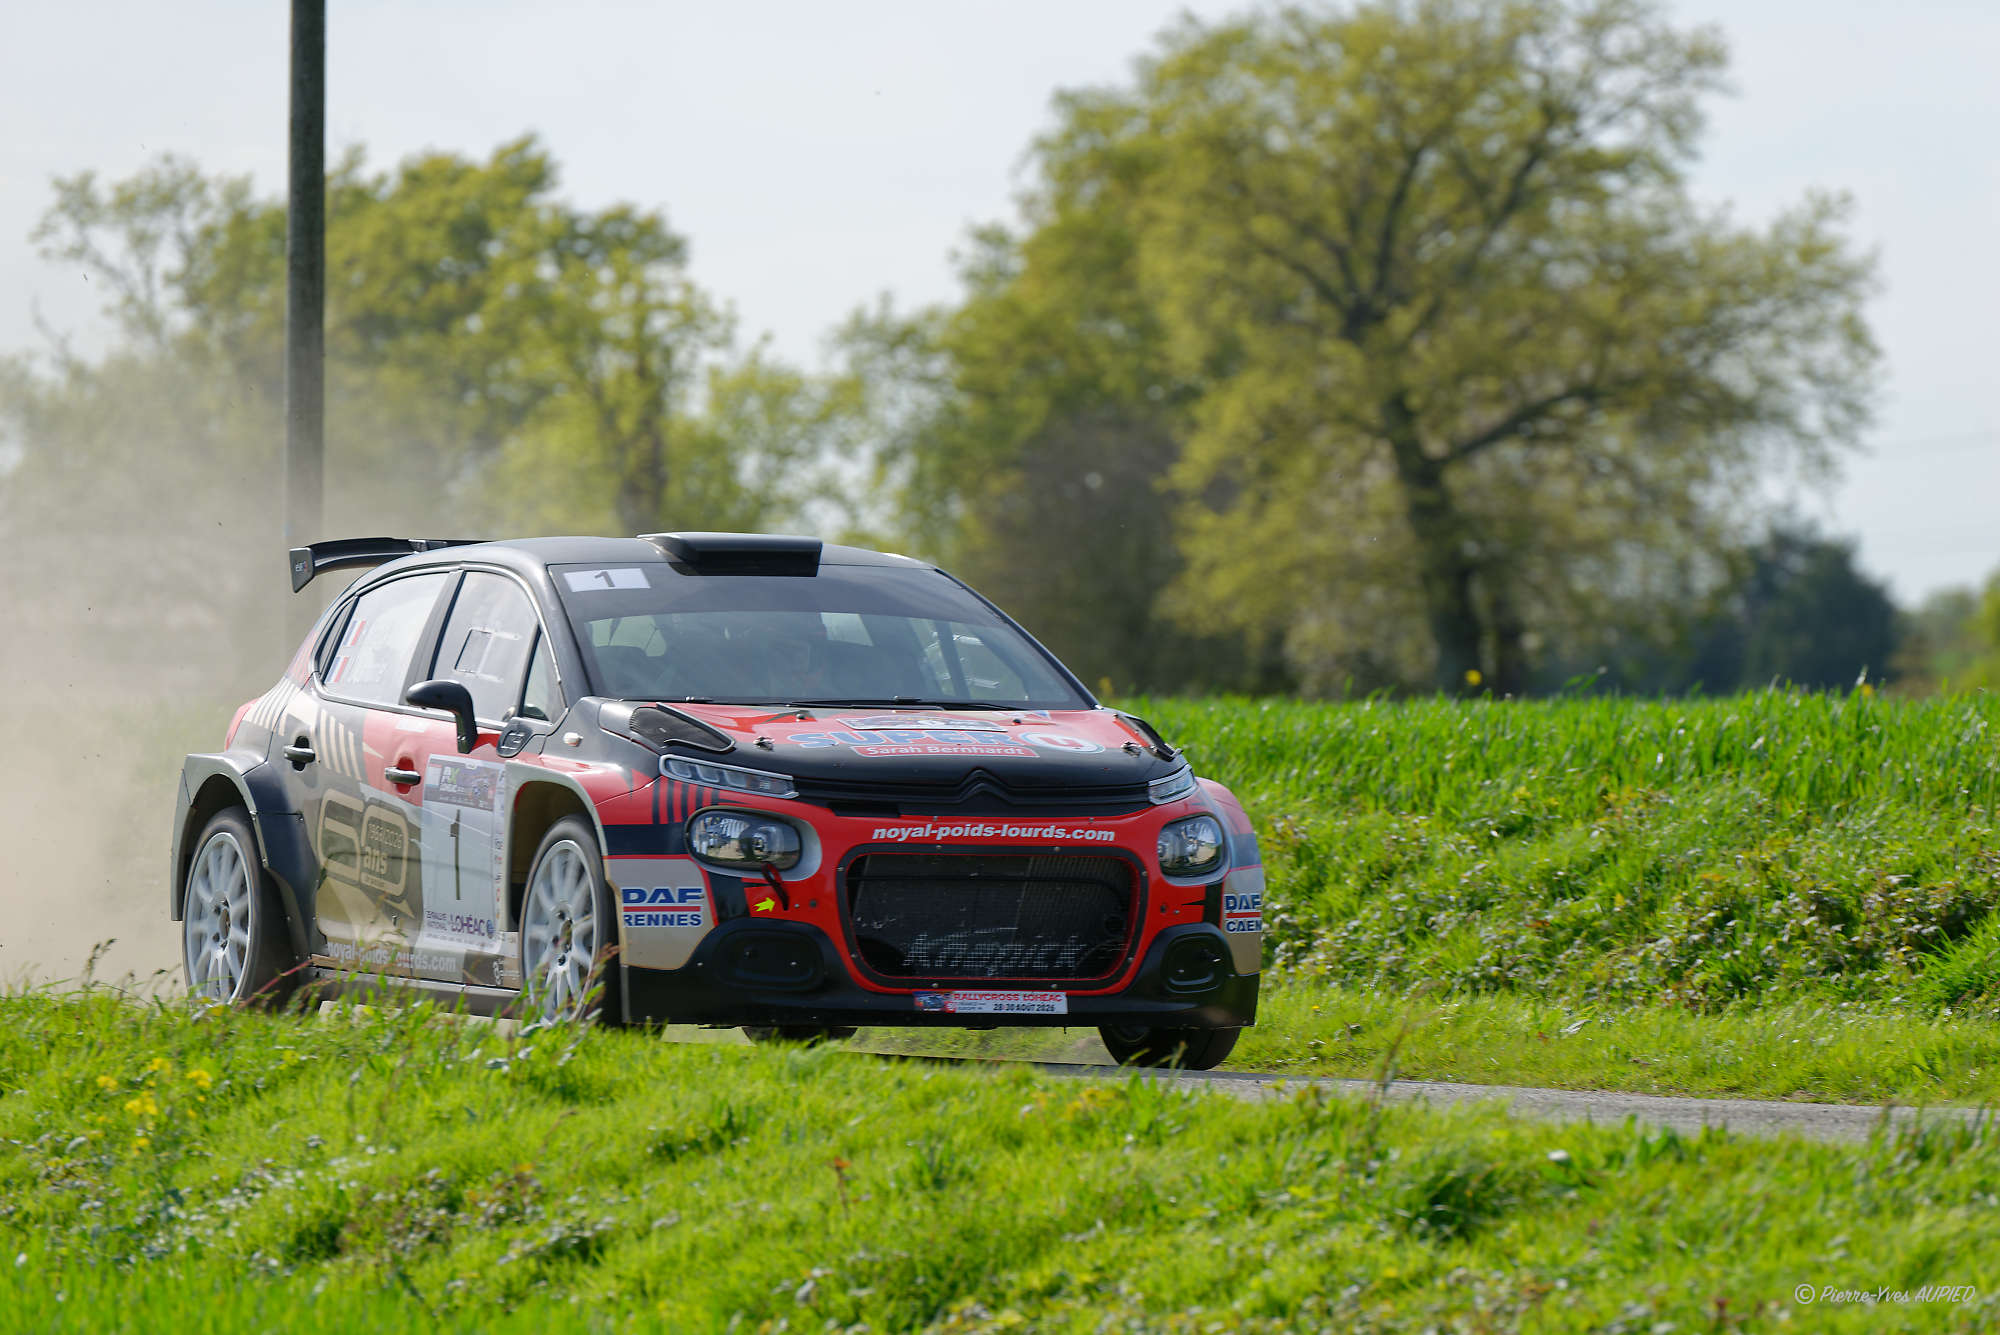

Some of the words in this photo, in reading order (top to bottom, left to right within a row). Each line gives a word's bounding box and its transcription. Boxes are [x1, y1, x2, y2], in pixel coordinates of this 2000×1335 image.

[594, 570, 616, 588] 1
[787, 730, 1027, 749] SUPER
[867, 745, 923, 755] Sarah
[926, 745, 1025, 756] Bernhardt
[872, 823, 1115, 842] noyal-poids-lourds.com
[363, 846, 388, 875] ans
[450, 809, 461, 900] 1
[621, 887, 704, 904] DAF
[1225, 894, 1262, 911] DAF
[623, 914, 702, 927] RENNES
[1226, 919, 1262, 932] CAEN
[327, 941, 457, 973] noyal-poids-ourds.com
[953, 992, 1019, 1001] RALLYCROSS
